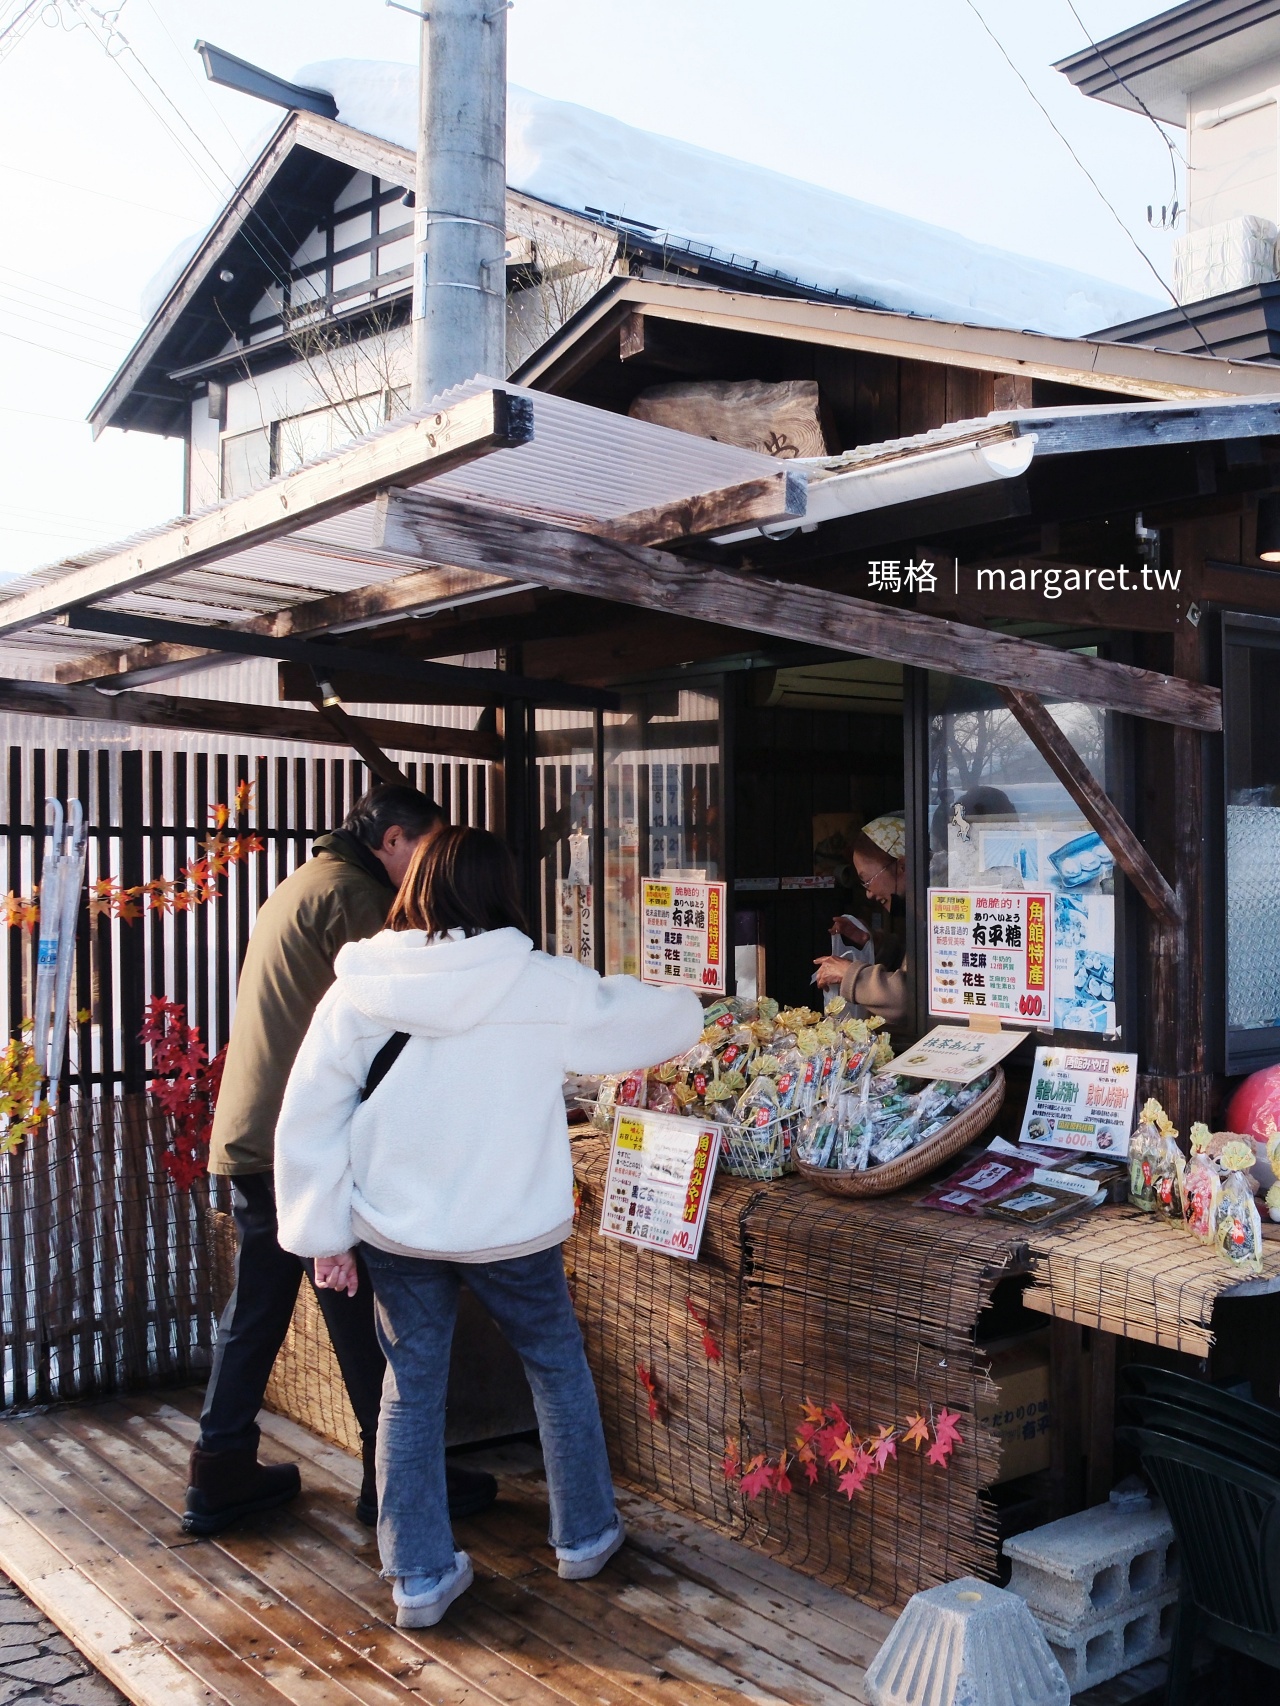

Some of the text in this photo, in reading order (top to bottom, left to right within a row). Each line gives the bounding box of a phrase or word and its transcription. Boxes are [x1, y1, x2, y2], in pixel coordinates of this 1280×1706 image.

[976, 898, 1021, 909] 脆脆的！
[672, 907, 705, 928] 有平糖
[974, 912, 1021, 923] ありへいとう
[972, 923, 1022, 948] 有平糖
[664, 948, 680, 961] 花生
[702, 967, 718, 986] 600
[962, 972, 985, 988] 花生
[1019, 994, 1043, 1016] 600
[1065, 1056, 1108, 1072] 角館みやげ
[684, 1135, 710, 1221] 角館みやげ
